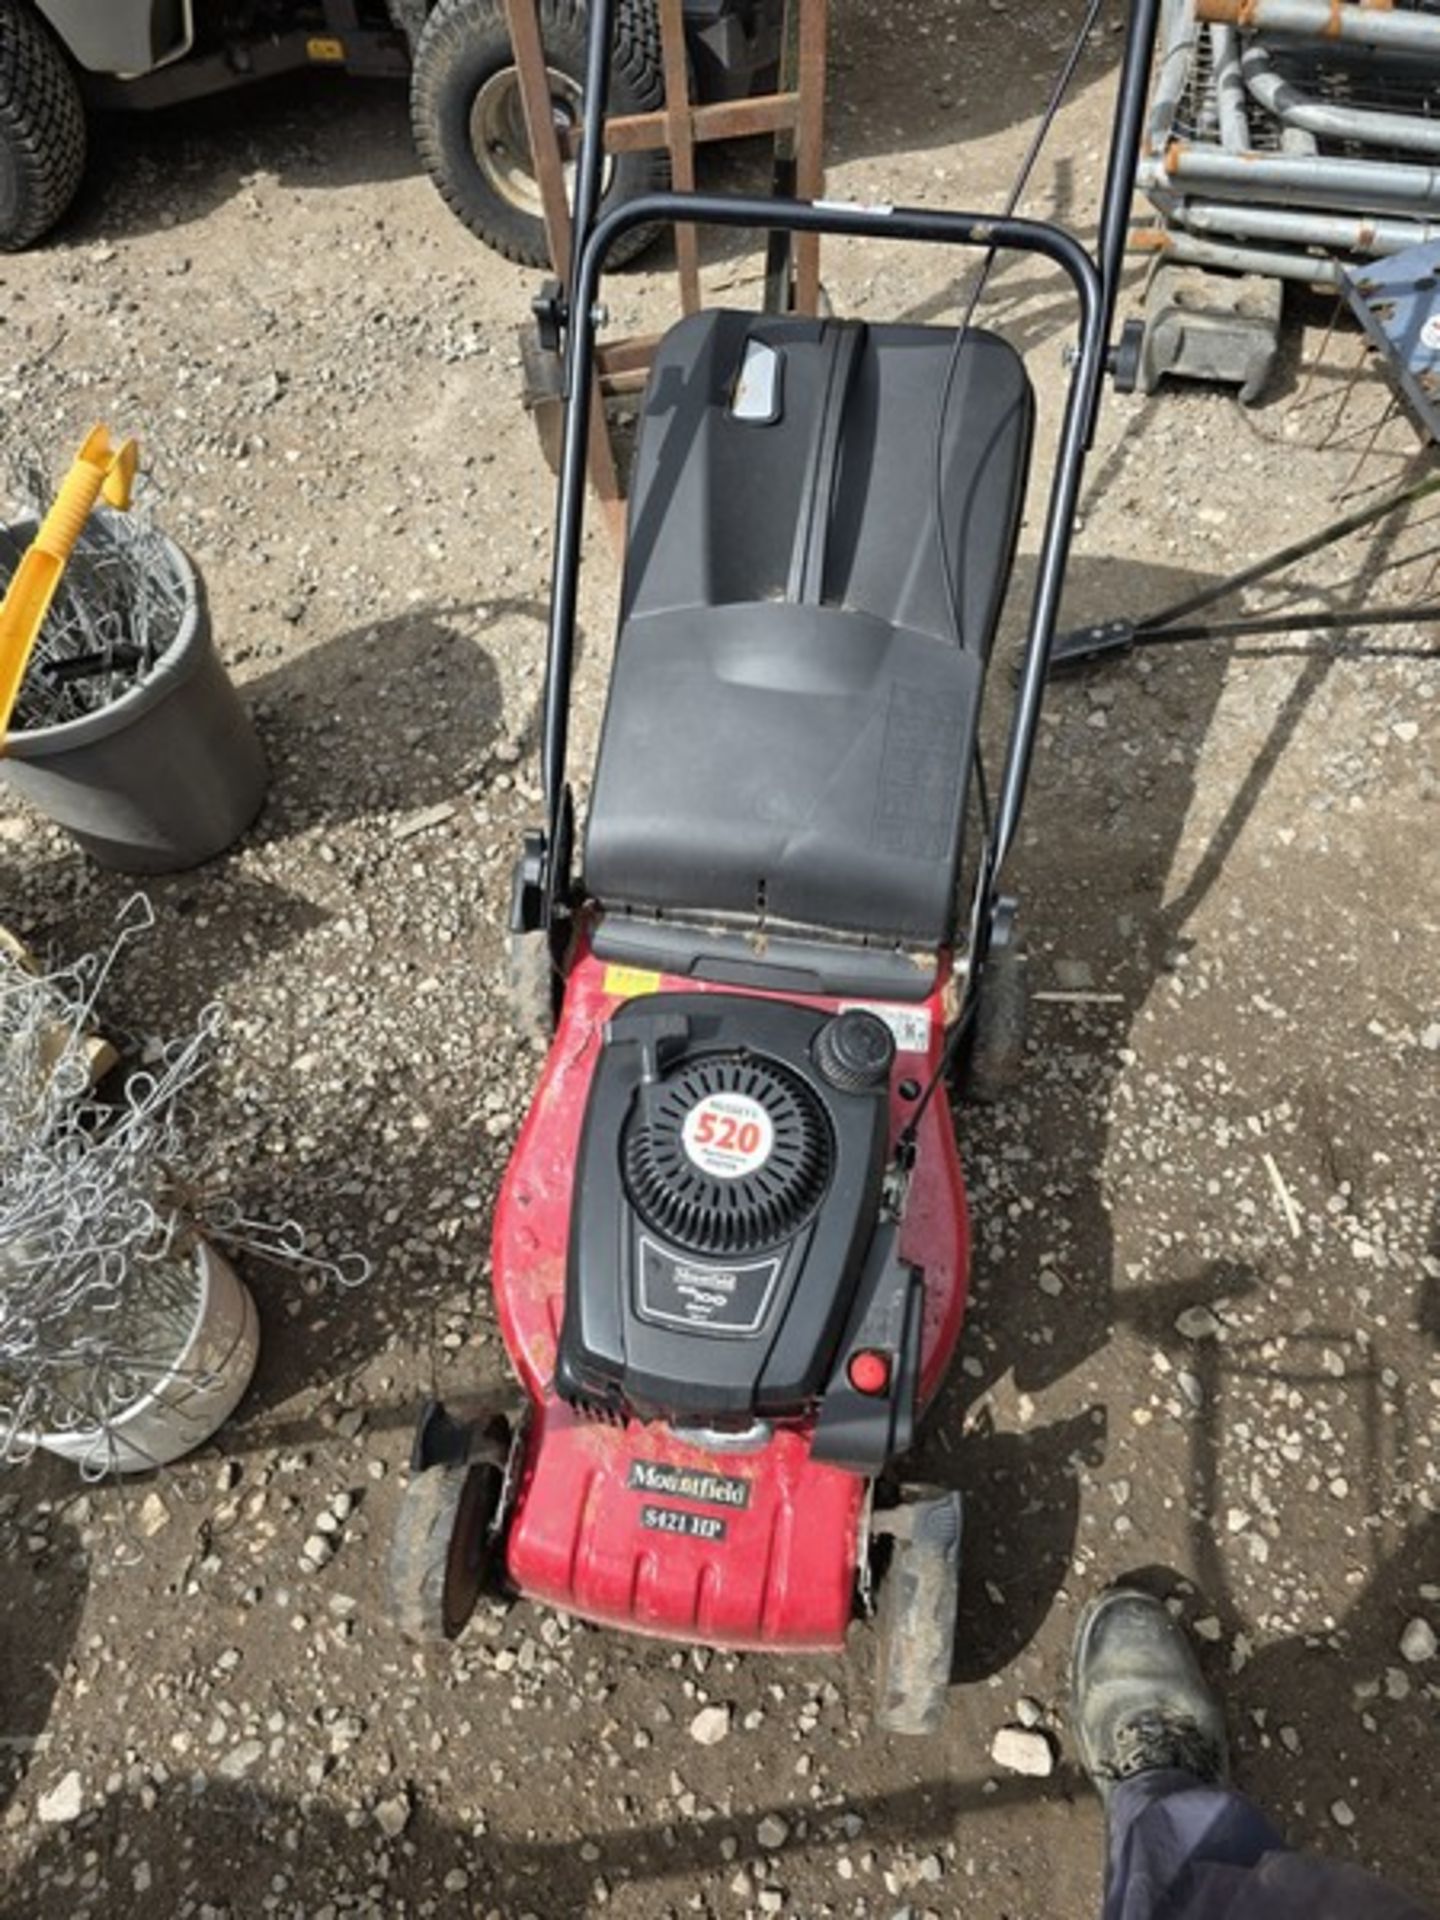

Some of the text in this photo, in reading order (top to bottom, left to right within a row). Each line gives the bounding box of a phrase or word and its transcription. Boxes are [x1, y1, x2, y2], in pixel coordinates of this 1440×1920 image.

[694, 1112, 761, 1154] 520
[630, 1464, 745, 1504] Mountfield
[645, 1510, 722, 1538] S421 HP
